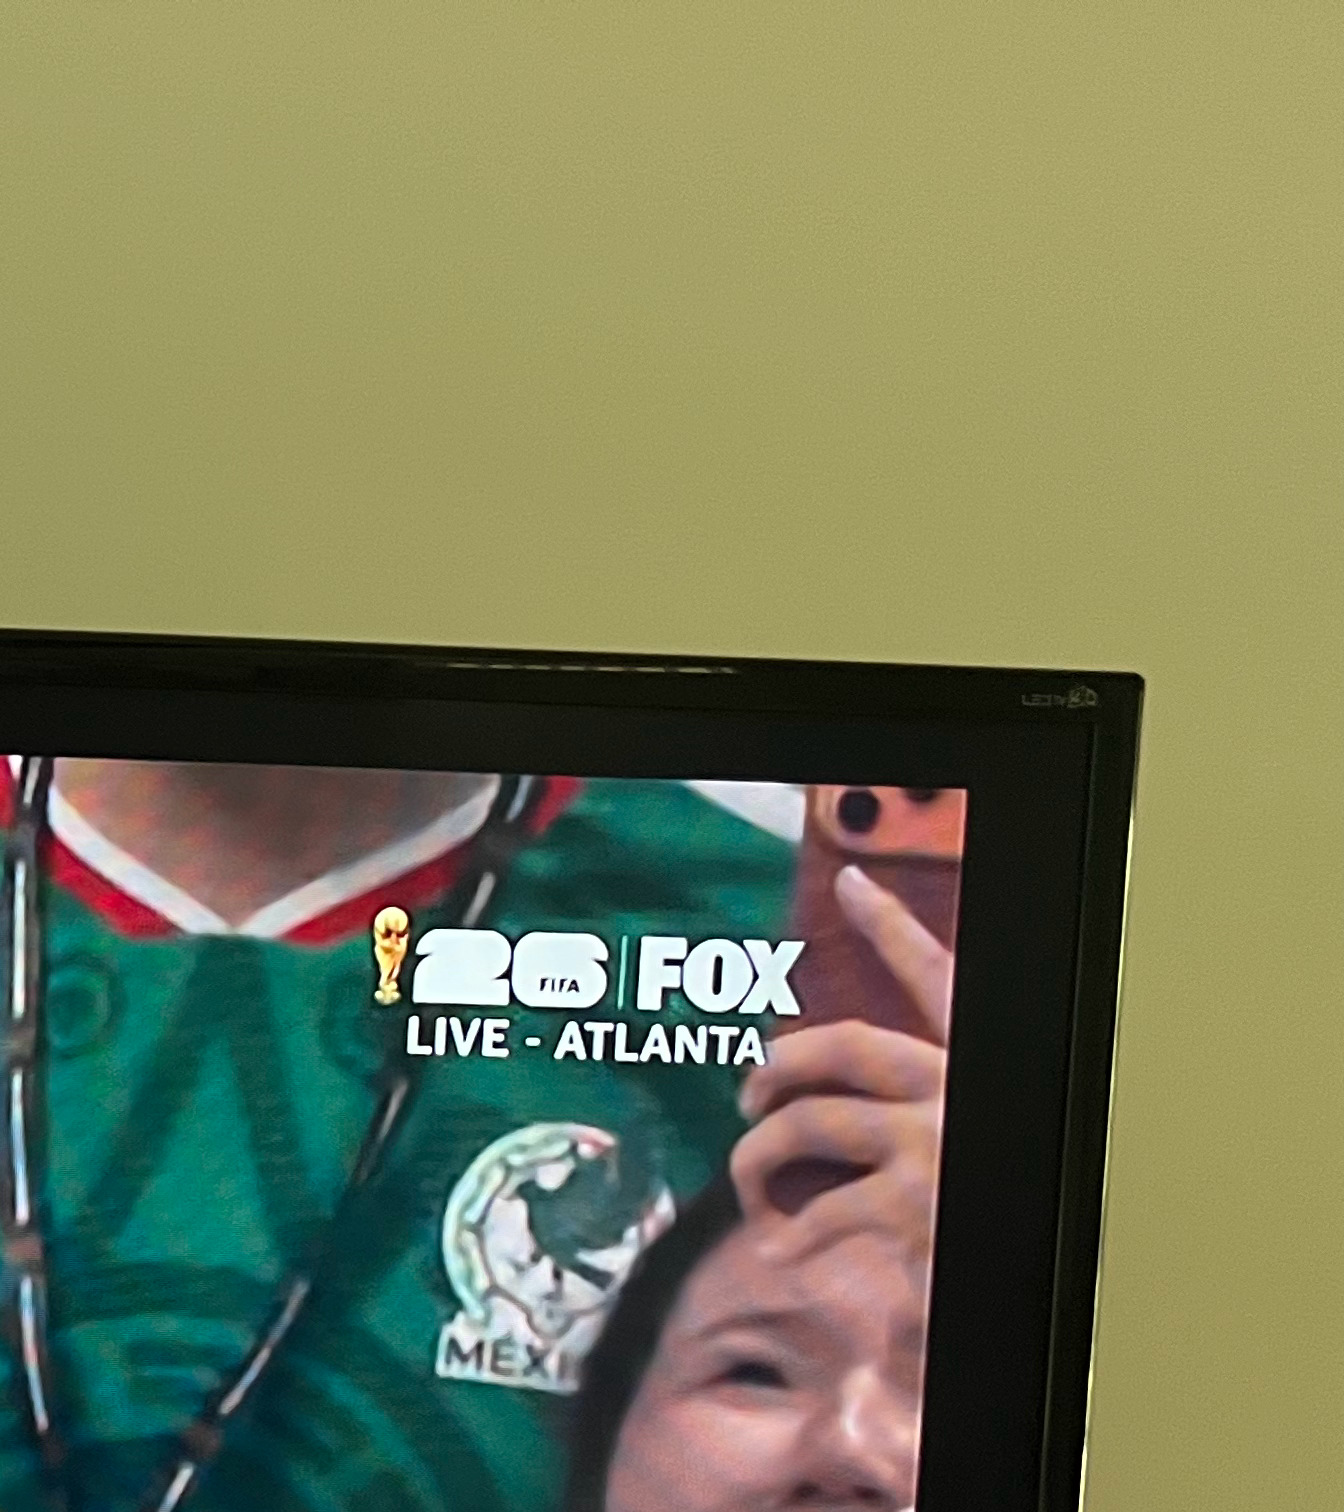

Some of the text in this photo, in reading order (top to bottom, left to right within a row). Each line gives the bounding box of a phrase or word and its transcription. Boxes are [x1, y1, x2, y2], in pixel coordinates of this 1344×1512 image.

[539, 977, 580, 993] FIFA
[637, 936, 805, 1015] FOX
[407, 1016, 765, 1066] LIVE - ATLANTA
